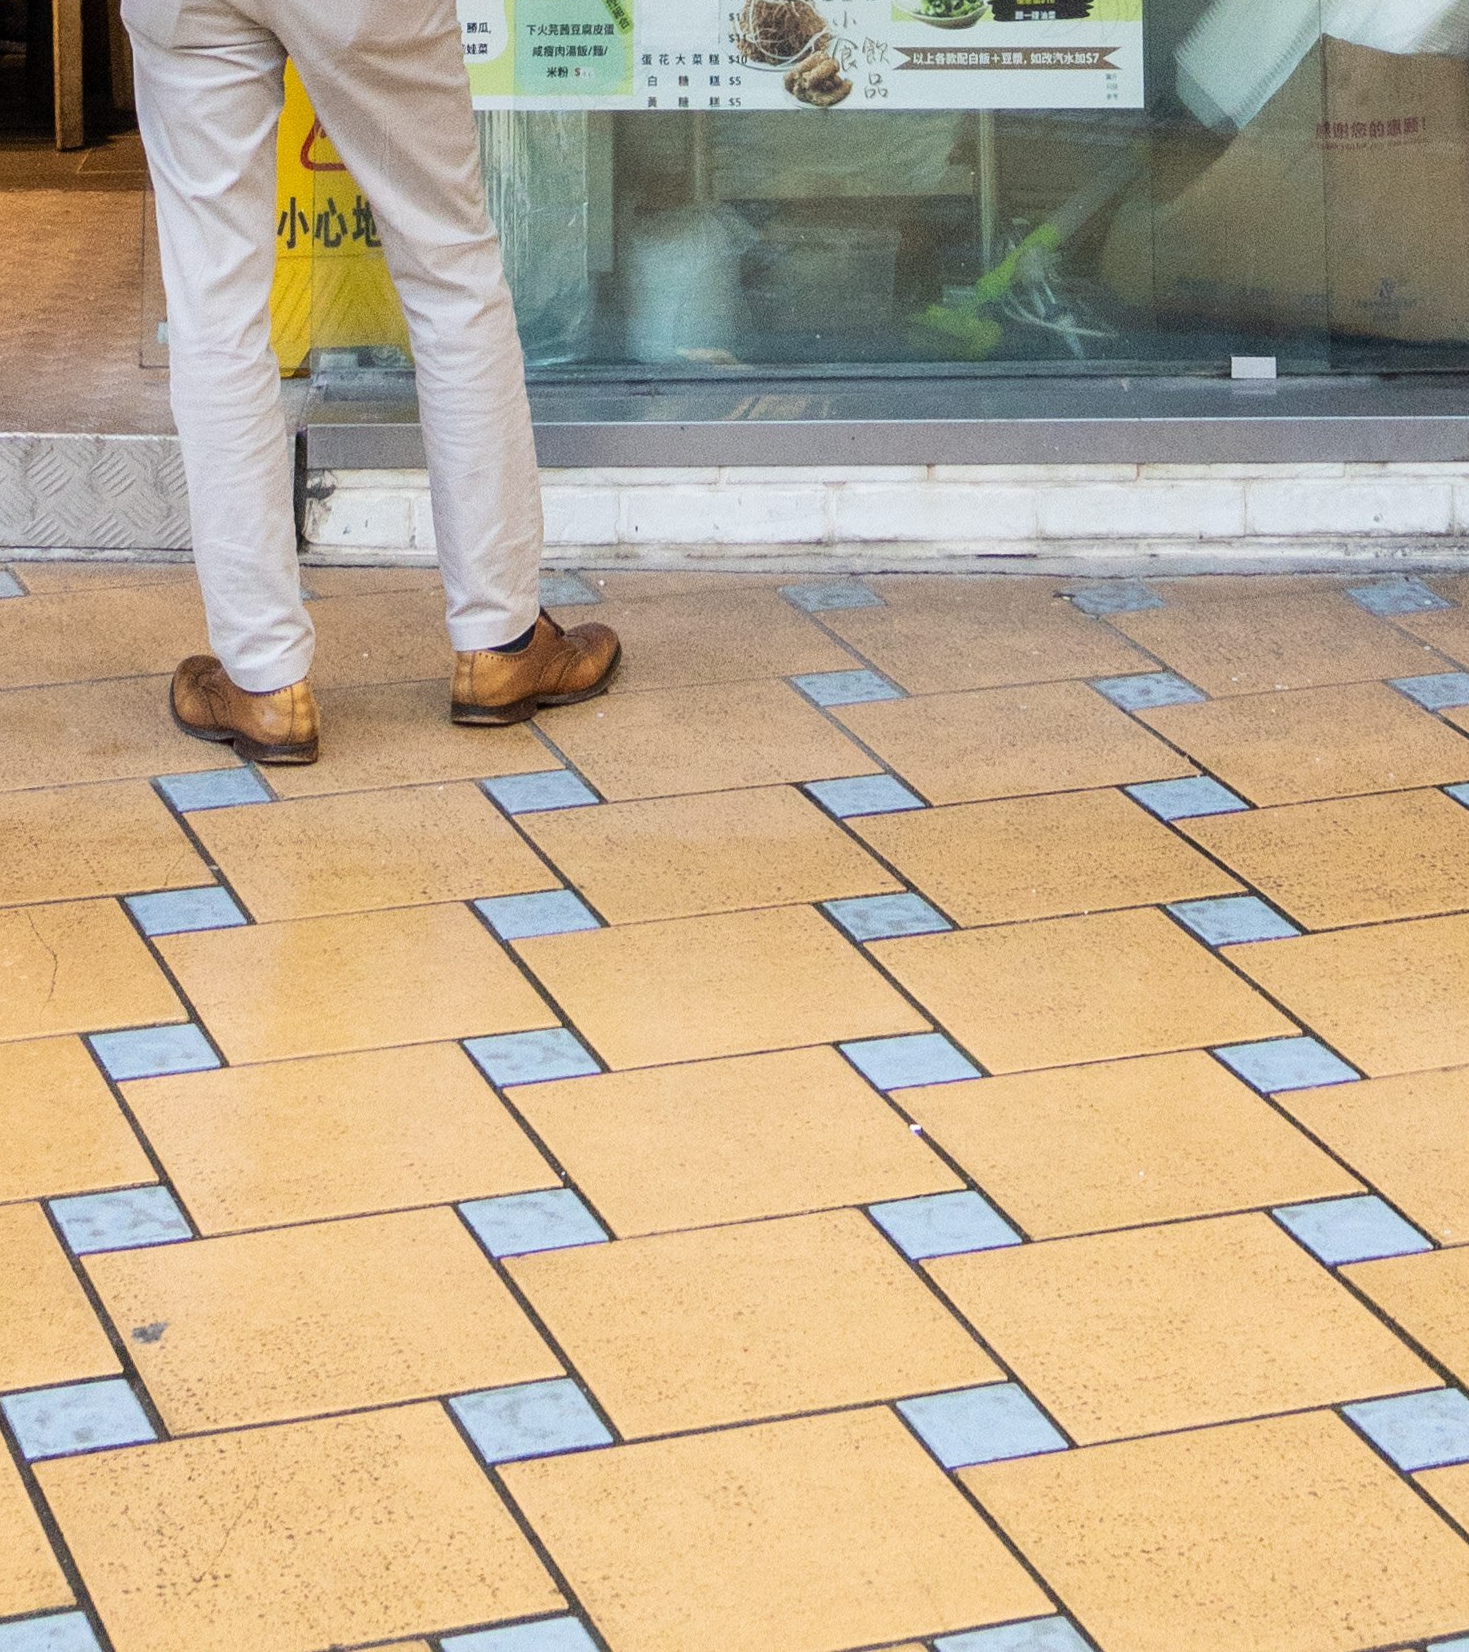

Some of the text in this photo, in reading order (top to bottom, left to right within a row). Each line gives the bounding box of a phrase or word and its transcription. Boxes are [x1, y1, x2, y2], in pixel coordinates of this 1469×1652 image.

[642, 55, 747, 65] 蛋花大菜糕 $10
[547, 67, 568, 78] 米粉
[729, 76, 741, 86] $5
[729, 98, 741, 107] $5
